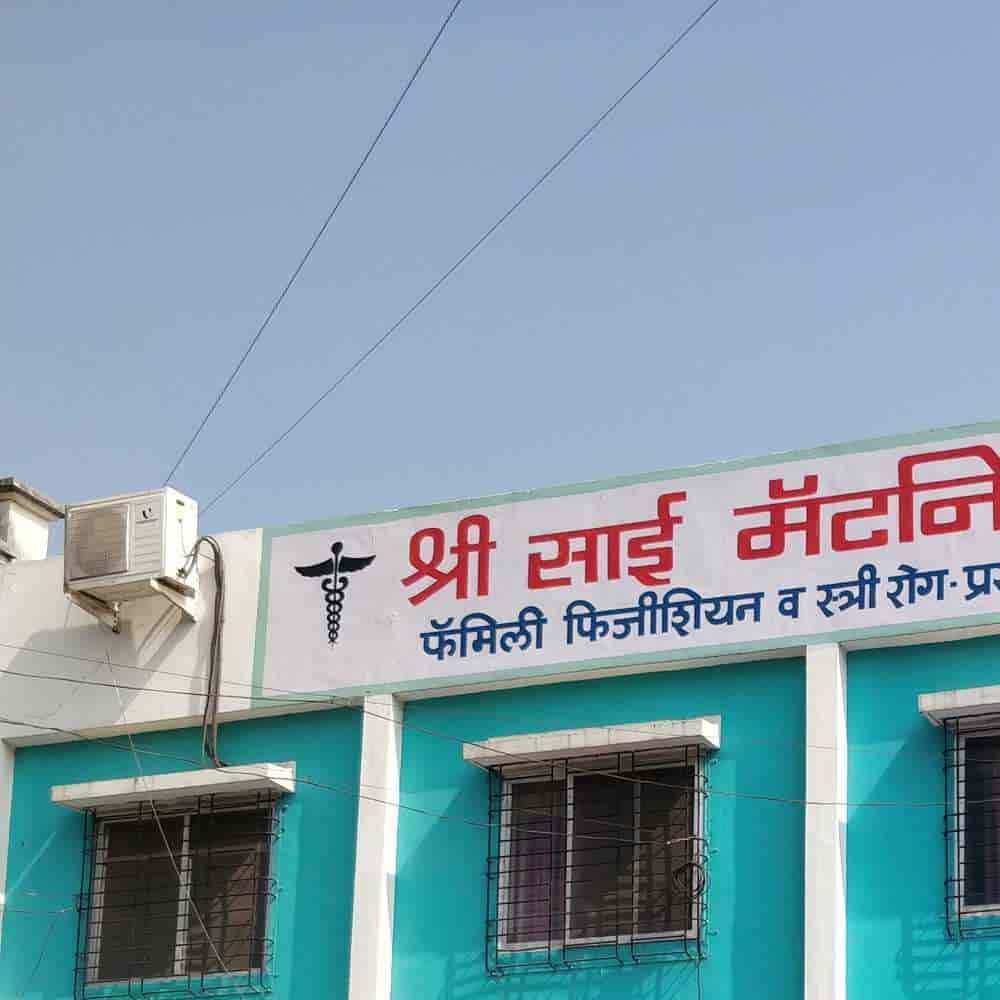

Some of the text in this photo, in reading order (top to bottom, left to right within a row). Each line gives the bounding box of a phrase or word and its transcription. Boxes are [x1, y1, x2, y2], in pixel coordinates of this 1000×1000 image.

[401, 513, 497, 606] श्री
[527, 491, 687, 590] साई
[420, 605, 547, 661] फॅमिली
[563, 587, 765, 646] फिजीशियन
[778, 585, 806, 619] व
[816, 563, 880, 618] स्त्री
